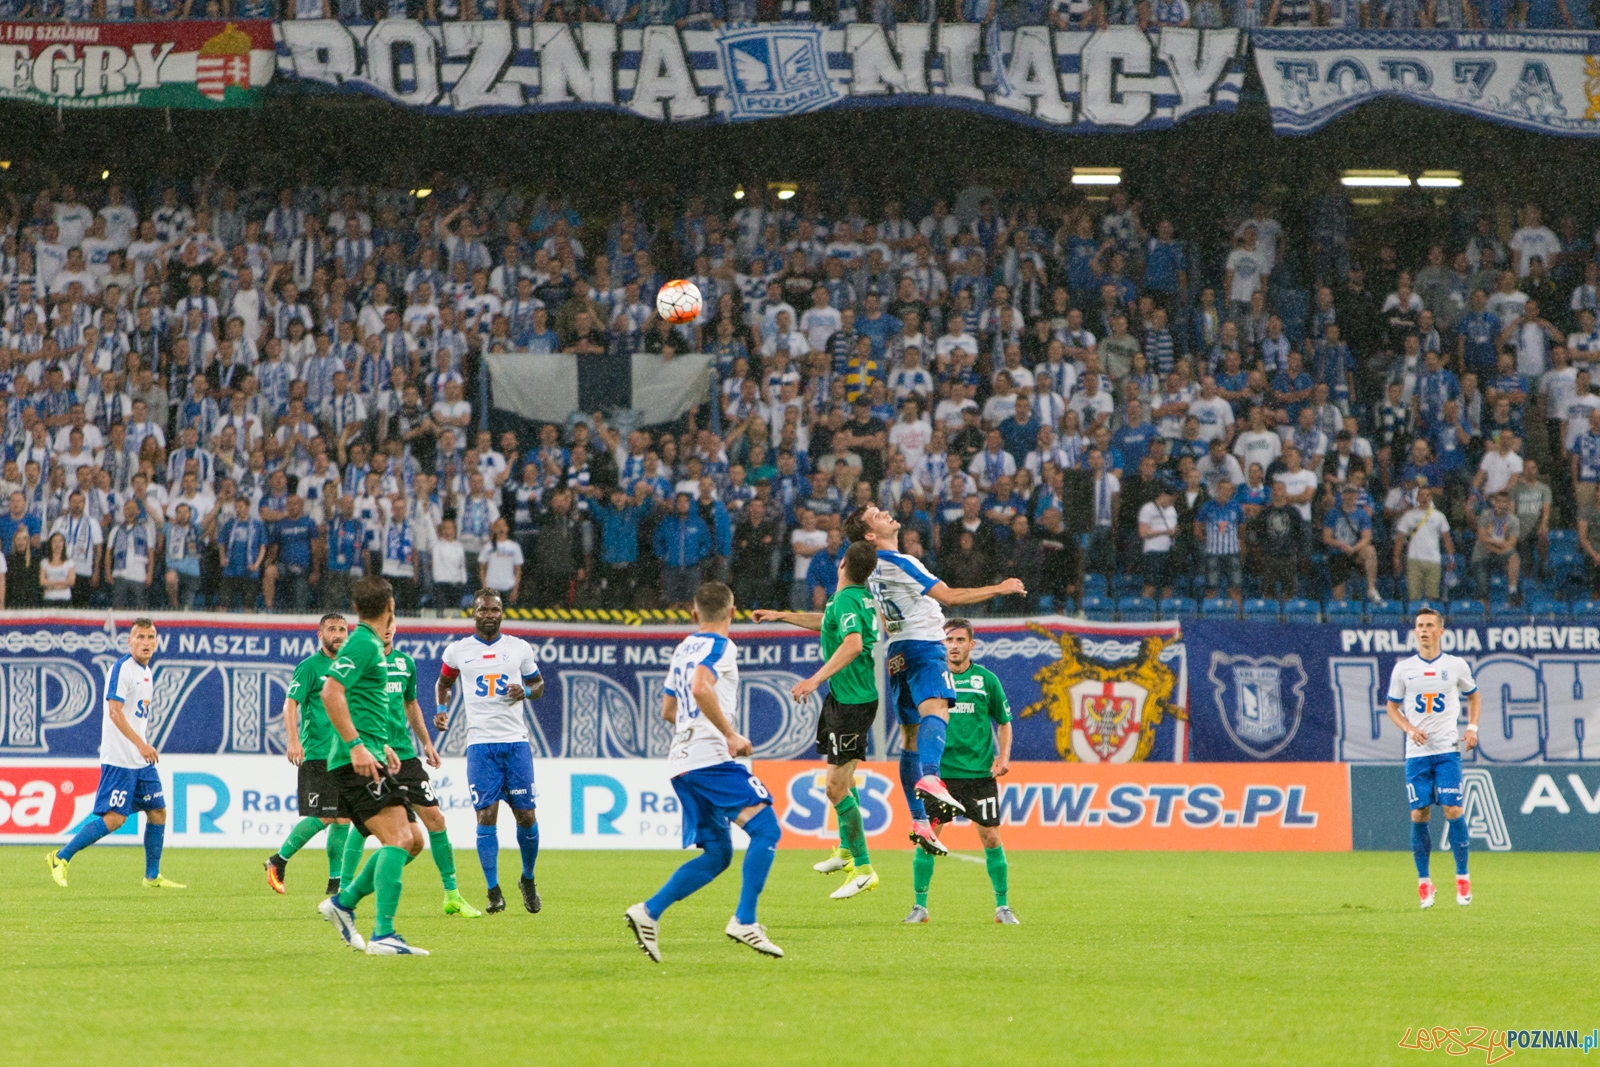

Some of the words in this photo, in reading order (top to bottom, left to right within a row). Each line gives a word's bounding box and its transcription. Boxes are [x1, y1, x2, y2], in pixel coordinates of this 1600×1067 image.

[1486, 34, 1590, 50] NIEPOKORNI
[179, 635, 270, 656] NASZEJ
[533, 637, 618, 665] RÓLUJE
[1341, 627, 1483, 653] PYRLADIA
[1487, 626, 1600, 650] FOREVER
[1414, 692, 1446, 714] STS
[108, 789, 128, 808] 66
[242, 789, 299, 812] Rad
[976, 796, 998, 820] 77
